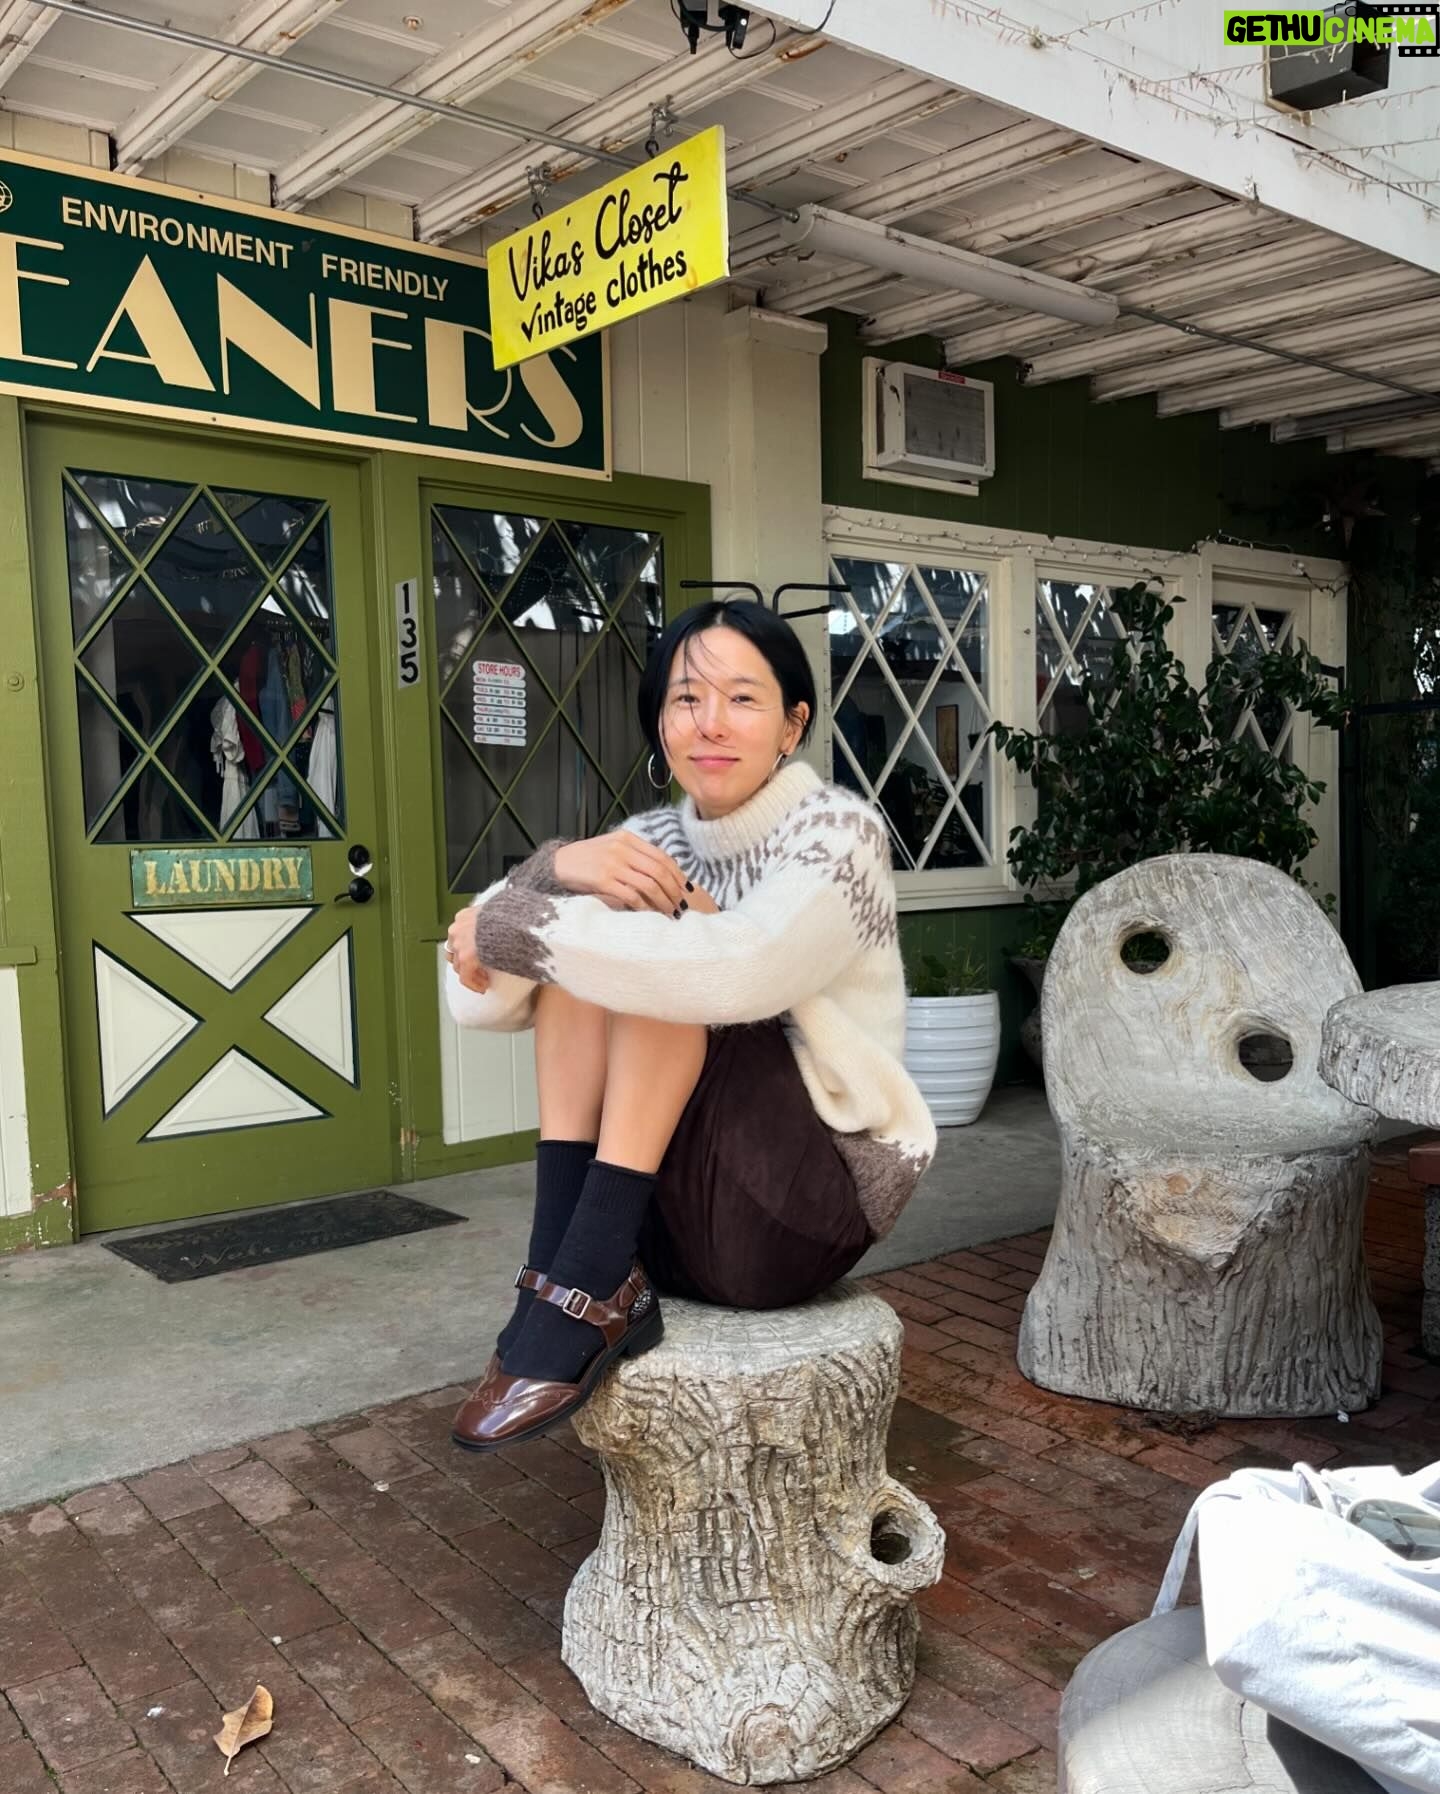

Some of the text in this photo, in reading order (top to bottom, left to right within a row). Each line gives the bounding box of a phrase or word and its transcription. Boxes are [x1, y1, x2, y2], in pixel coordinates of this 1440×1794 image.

[62, 196, 449, 301] ENVIRONMENT FRIENDLY
[508, 161, 689, 301] Vika's Closet
[606, 248, 688, 308] clothes
[400, 582, 419, 684] 135
[478, 663, 521, 678] STORE HOURS
[144, 857, 304, 895] LAUNDRY
